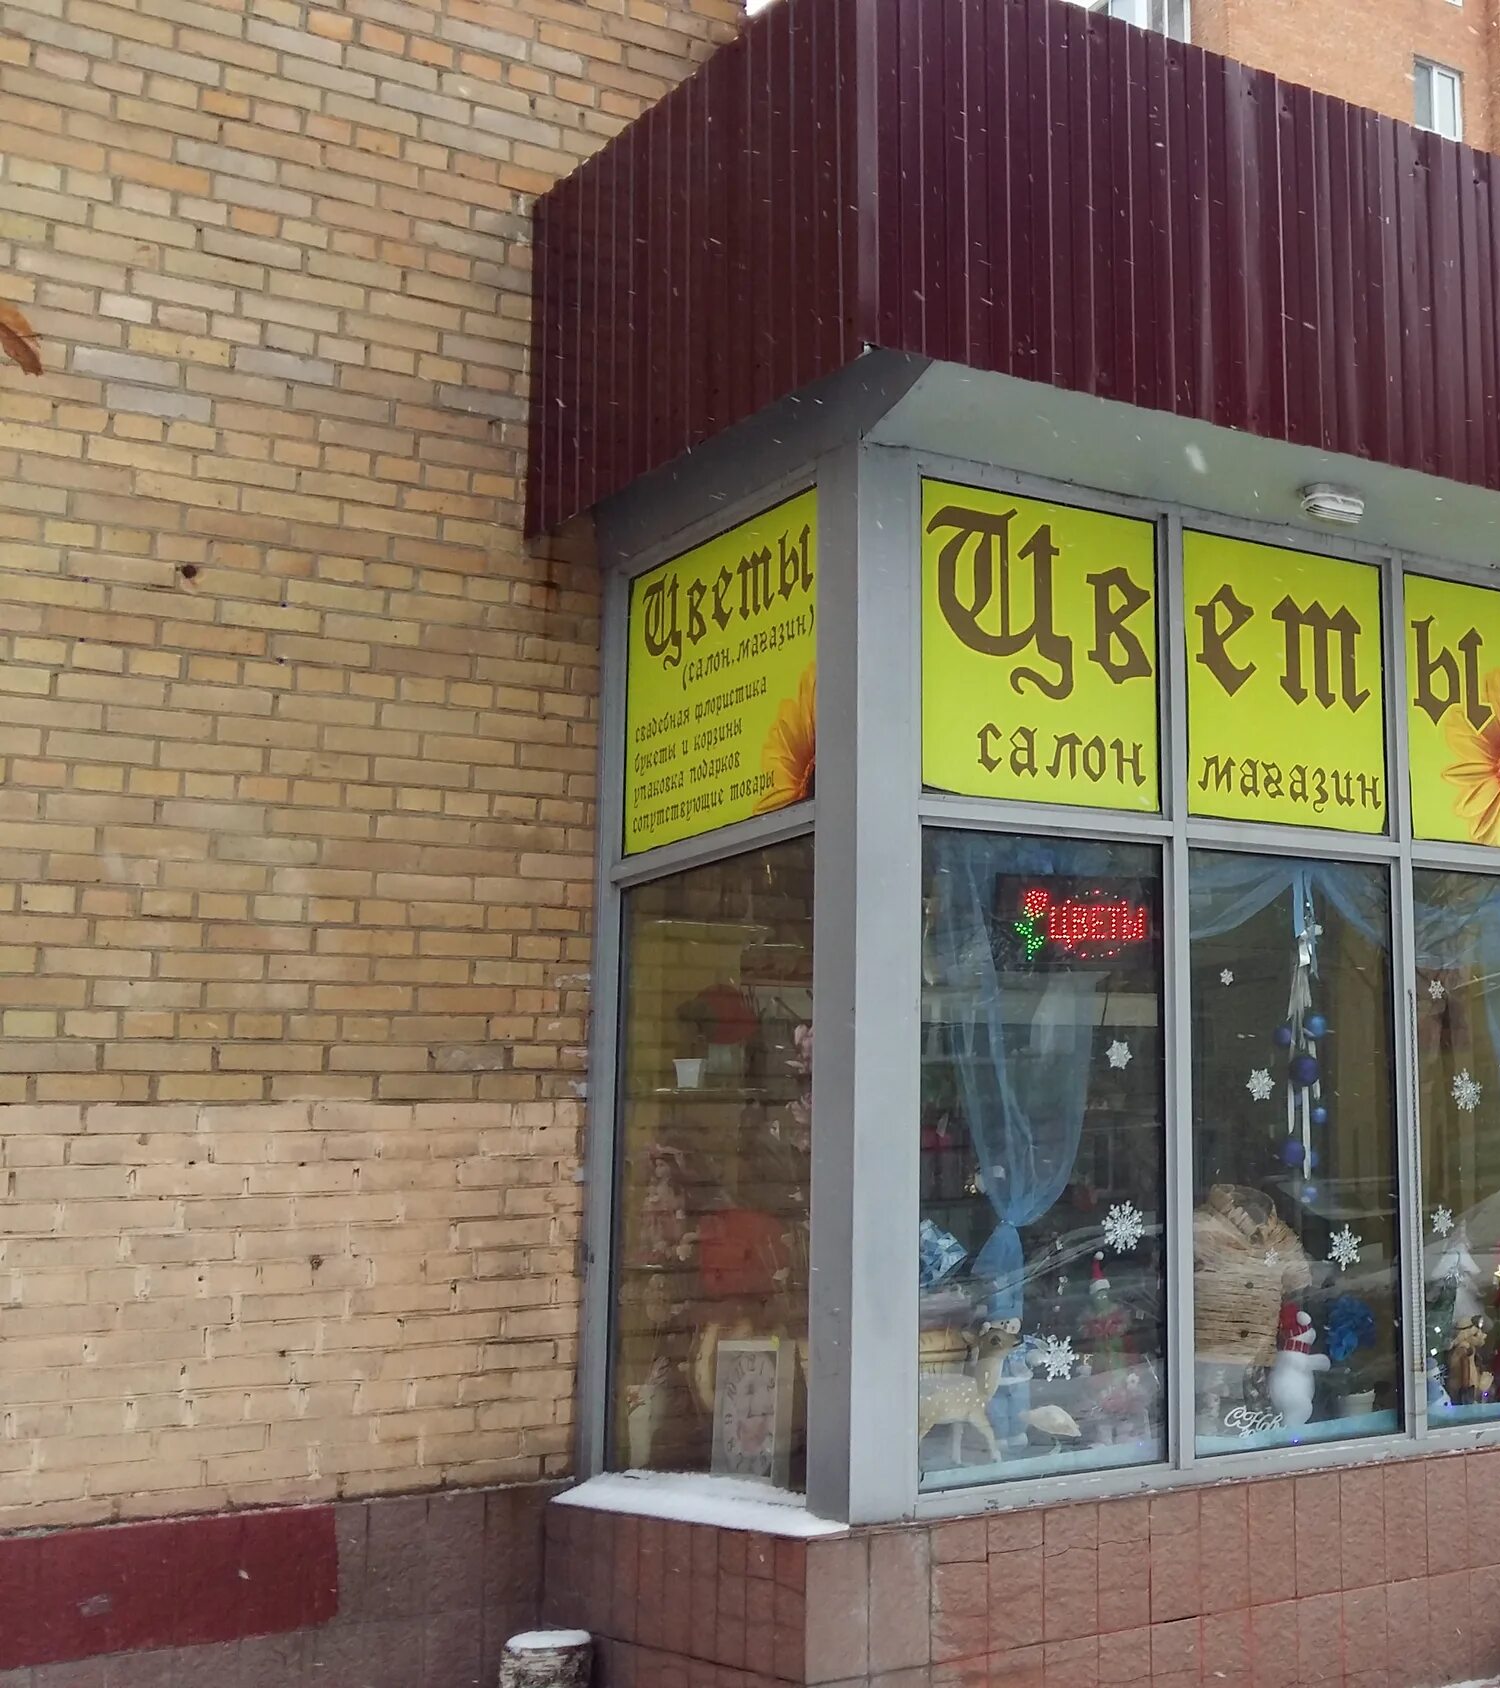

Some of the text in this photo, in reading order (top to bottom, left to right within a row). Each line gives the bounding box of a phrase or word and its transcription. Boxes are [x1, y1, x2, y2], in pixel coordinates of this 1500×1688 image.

[642, 523, 814, 670] Цветы
[635, 676, 767, 744] свадебная флористика
[634, 718, 742, 776] букеты и корзины
[976, 721, 1382, 812] салон магазин
[632, 770, 775, 833] сопутствующие товары
[633, 751, 740, 808] упаковка подарков
[1050, 906, 1144, 949] ЦВЕТЫ
